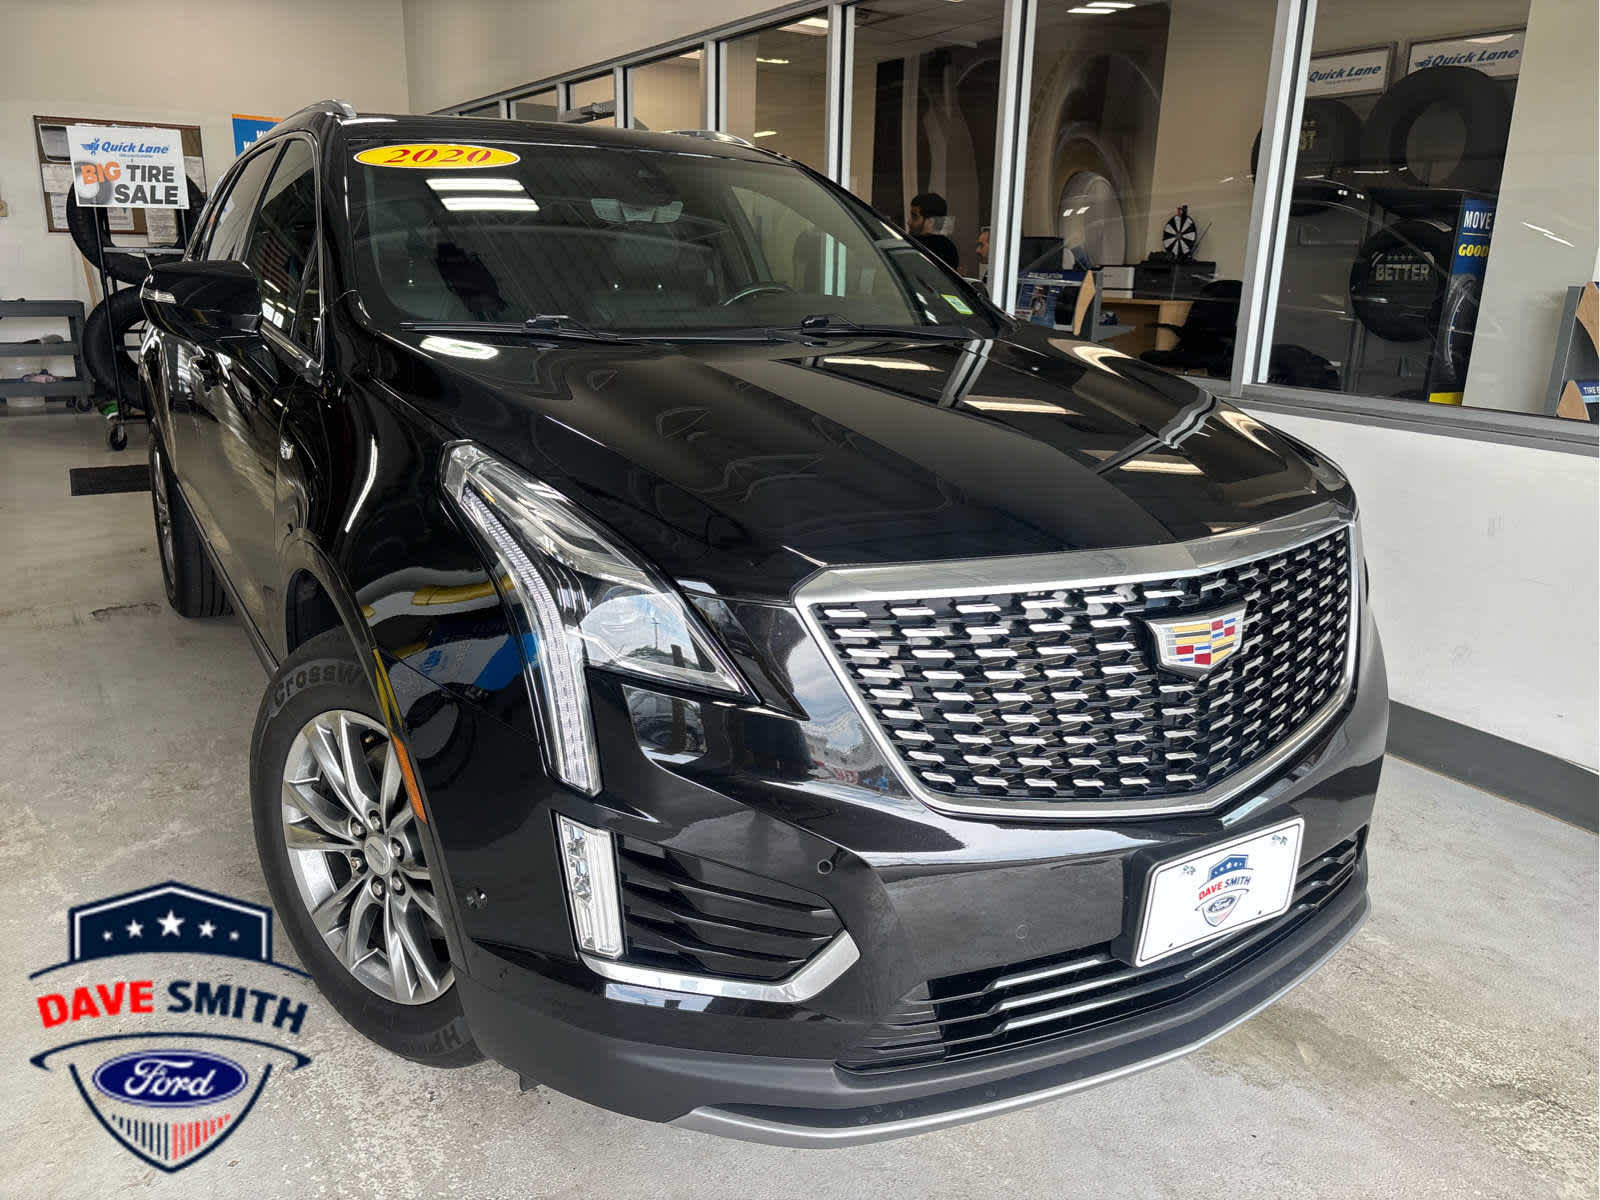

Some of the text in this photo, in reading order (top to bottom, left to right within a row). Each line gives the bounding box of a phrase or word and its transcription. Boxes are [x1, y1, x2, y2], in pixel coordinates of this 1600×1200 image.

[1432, 49, 1519, 68] Quick Lane
[1309, 67, 1346, 83] Quick
[1347, 65, 1382, 77] Lane
[101, 140, 169, 154] Quick Lane
[383, 148, 492, 164] 2020
[80, 161, 175, 185] BIG TIRE
[114, 184, 179, 205] SALE
[1463, 210, 1493, 230] MOVE
[1375, 263, 1431, 281] BETTER
[1199, 876, 1250, 899] DAVE SMITH
